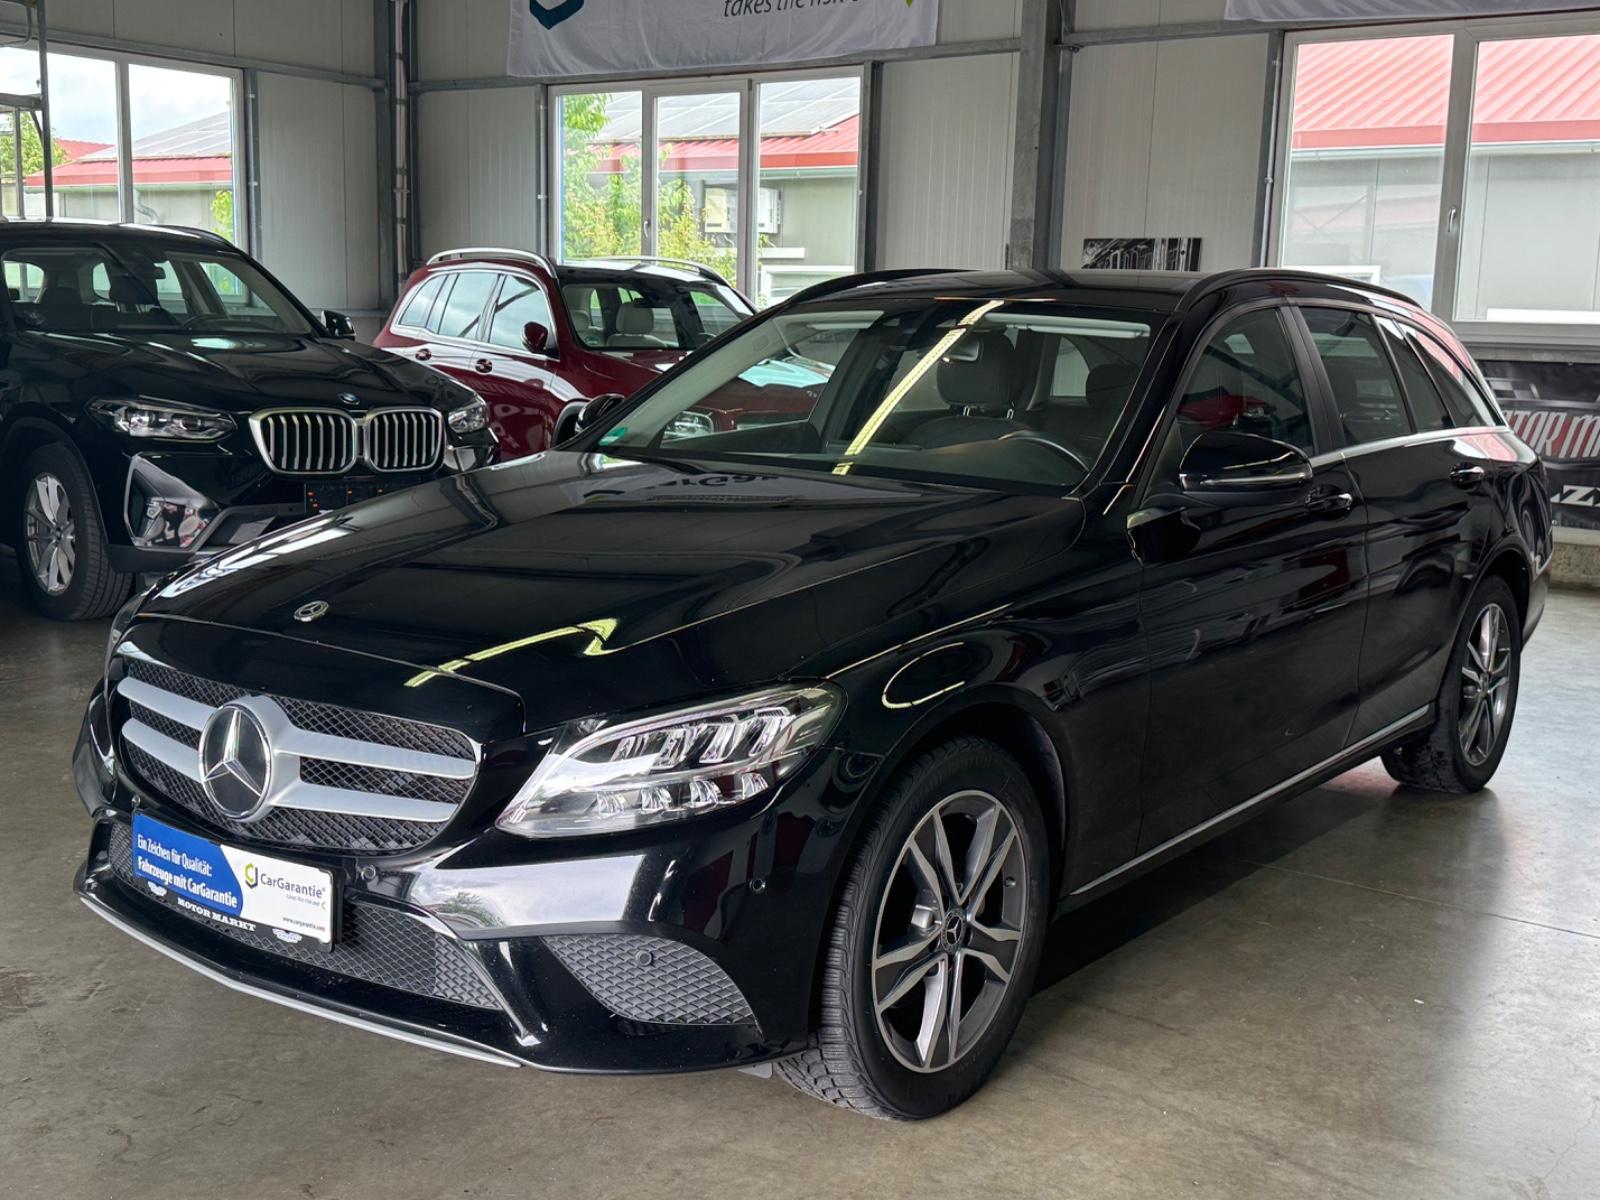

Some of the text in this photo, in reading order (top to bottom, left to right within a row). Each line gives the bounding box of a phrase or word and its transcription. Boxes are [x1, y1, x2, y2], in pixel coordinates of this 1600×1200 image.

[724, 0, 772, 17] takes
[137, 833, 213, 878] Ein Zeichen für Qualität:
[138, 855, 238, 909] Fahrzeuge mit CarGarantie
[177, 896, 257, 932] MOTOR MARKT
